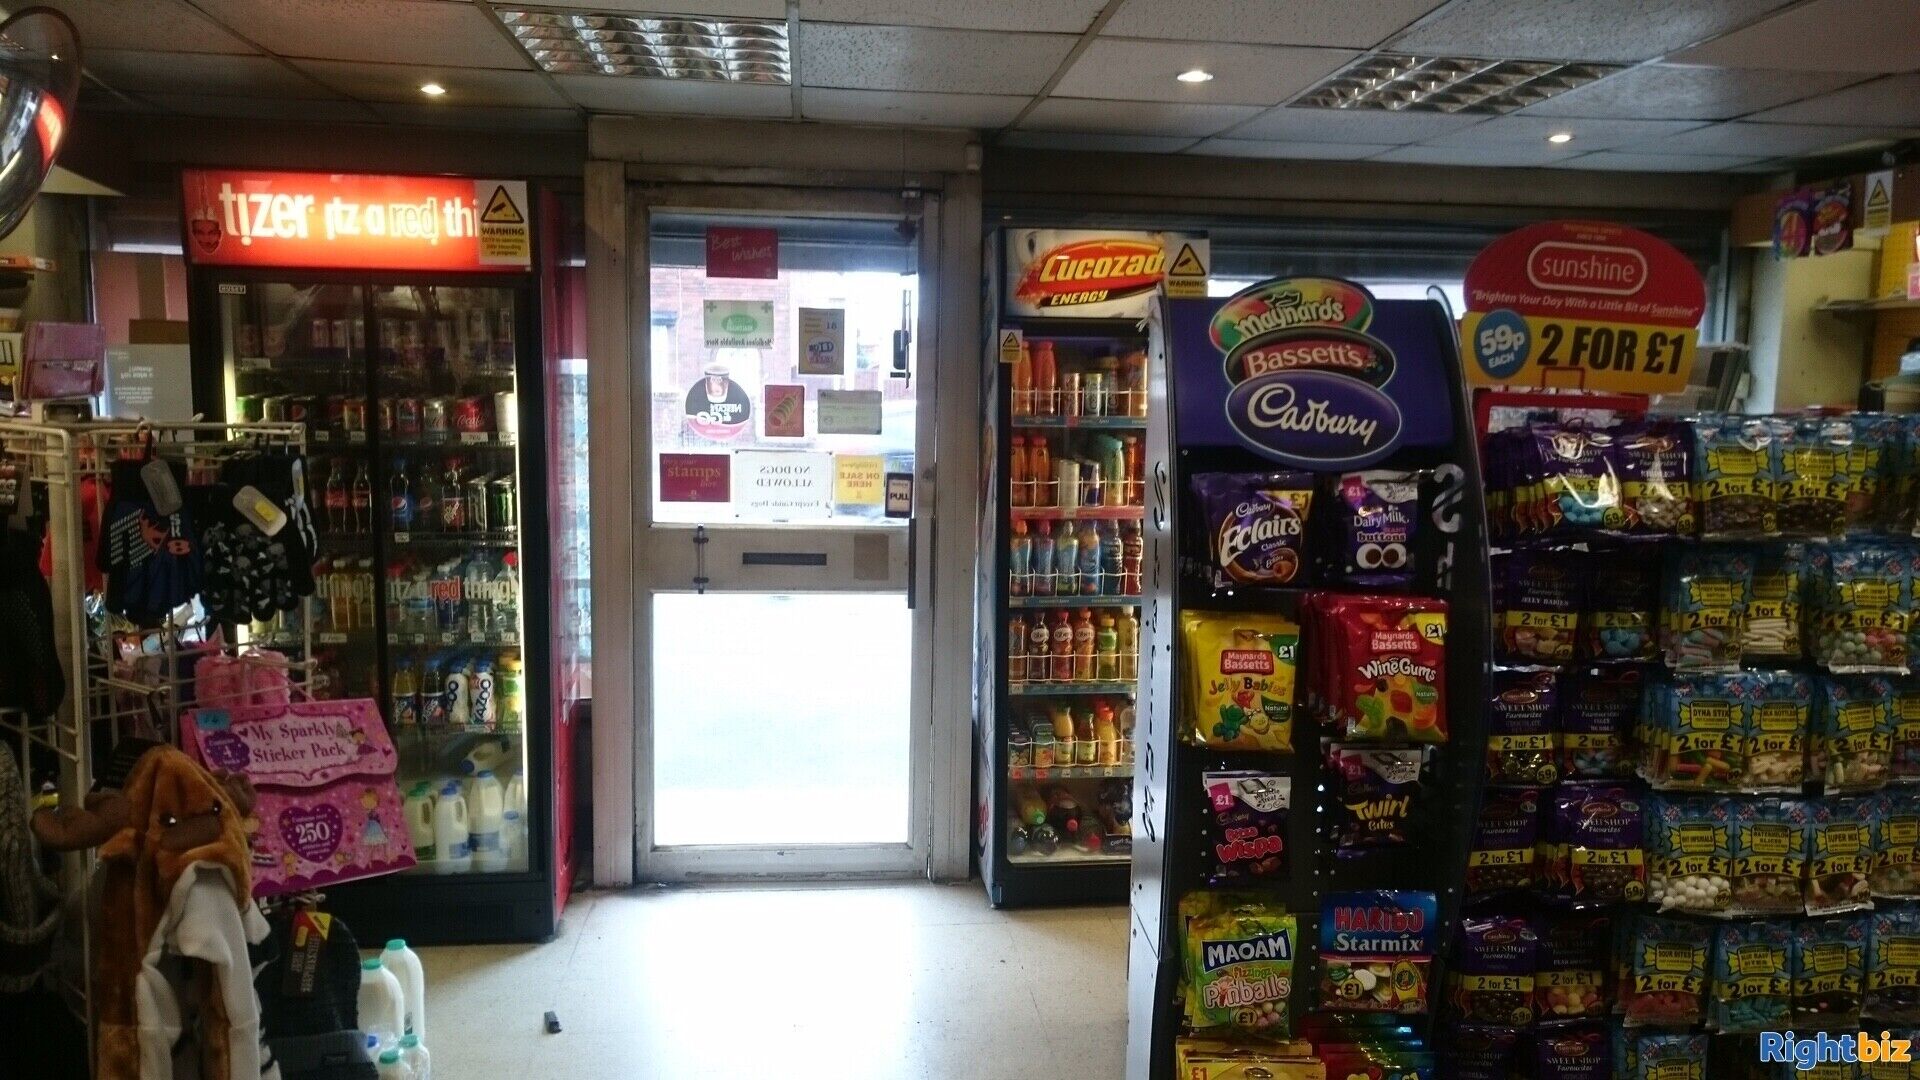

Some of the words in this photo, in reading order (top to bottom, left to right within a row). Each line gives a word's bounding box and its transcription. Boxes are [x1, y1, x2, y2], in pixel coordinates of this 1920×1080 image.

[388, 196, 439, 245] red
[481, 227, 525, 236] WARNING
[1541, 255, 1635, 283] sunshine
[1168, 280, 1206, 288] WARNING
[1051, 290, 1109, 305] ENERGY
[1519, 294, 1540, 305] Your
[1542, 295, 1562, 308] Day
[1565, 297, 1587, 308] With
[1590, 300, 1595, 308] a
[1598, 300, 1623, 311] Little
[1626, 302, 1638, 312] Bit
[1639, 303, 1650, 313] of
[1480, 325, 1525, 355] 59p
[1537, 324, 1563, 366] 2
[1569, 327, 1638, 372] FOR
[1643, 332, 1685, 374] £1
[1246, 344, 1363, 378] Bassett's
[1489, 352, 1515, 368] EACH
[1248, 383, 1377, 446] Cadbury
[667, 465, 721, 480] stamps
[1347, 486, 1361, 497] £1
[1639, 484, 1648, 495] 2
[1671, 483, 1685, 495] £1
[1707, 481, 1723, 496] 2
[1725, 482, 1746, 494] for
[1752, 479, 1773, 496] £1
[1780, 482, 1794, 498] 2
[1798, 485, 1820, 496] for
[890, 493, 909, 501] PULL
[1235, 502, 1271, 518] Cadbury
[1353, 515, 1381, 528] Dairy
[1382, 511, 1407, 524] Milk
[1220, 516, 1301, 567] Eclairs
[1357, 532, 1406, 542] buttons
[1261, 539, 1287, 551] Classic
[430, 575, 460, 600] red
[1755, 605, 1775, 616] for
[1521, 613, 1531, 625] 2
[1534, 616, 1547, 626] for
[1551, 615, 1568, 627] £1
[1605, 614, 1614, 625] 2
[1689, 613, 1701, 629] 2
[1704, 614, 1724, 626] for
[1838, 613, 1855, 628] 2
[1859, 615, 1876, 626] for
[1375, 632, 1414, 642] Maynards
[1425, 624, 1443, 638] £1
[1371, 639, 1418, 650] Bassetts
[1228, 652, 1267, 661] Maynards
[1279, 646, 1295, 659] £1
[1224, 659, 1270, 670] Bassetts
[1209, 678, 1240, 695] Jelly
[1243, 677, 1287, 696] Babies
[1264, 704, 1288, 712] Natural
[1693, 709, 1711, 717] DYNA
[251, 725, 271, 745] My
[280, 721, 335, 742] Sparkly
[1502, 737, 1512, 749] 2
[1515, 740, 1527, 749] for
[1529, 736, 1546, 749] £1
[1578, 736, 1588, 746] 2
[1591, 737, 1606, 747] for
[1677, 736, 1691, 751] 2
[1693, 738, 1715, 750] for
[1721, 733, 1744, 750] £1
[1751, 738, 1760, 754] 2
[1763, 738, 1784, 751] for
[1834, 737, 1848, 750] 2
[1853, 738, 1867, 751] for
[1870, 733, 1892, 750] £1
[252, 746, 305, 763] Sticker
[312, 742, 347, 759] Pack
[1346, 794, 1409, 821] Twirl
[295, 820, 330, 843] 250
[1368, 819, 1394, 831] Bites
[1479, 853, 1489, 865] 2
[1492, 855, 1504, 864] for
[1506, 851, 1524, 863] £1
[1587, 852, 1596, 863] 2
[1610, 851, 1629, 863] £1
[1877, 851, 1890, 866] 2
[1892, 853, 1910, 864] for
[1669, 860, 1683, 876] 2
[1686, 862, 1703, 873] for
[1707, 858, 1732, 874] £1
[1737, 860, 1750, 876] 2
[1754, 862, 1778, 873] for
[1815, 860, 1826, 876] 2
[1831, 862, 1849, 874] for
[1853, 856, 1872, 872] £1
[1626, 885, 1644, 897] 59p
[1334, 906, 1424, 932] HARIBO
[1335, 933, 1421, 952] Starmix
[1207, 936, 1287, 967] MAOAM
[1478, 977, 1486, 990] 2
[1488, 980, 1501, 989] for
[1503, 977, 1521, 990] £1
[1551, 973, 1560, 985] 2
[1562, 975, 1574, 985] for
[1577, 972, 1595, 984] £1
[1640, 974, 1652, 991] 2
[1657, 978, 1678, 991] for
[1802, 979, 1816, 993] 2
[1818, 978, 1835, 991] for
[1876, 973, 1888, 987] 2
[1890, 972, 1910, 986] for
[1344, 983, 1360, 995] £1
[1728, 985, 1740, 1000] 2
[1744, 982, 1762, 994] for
[1239, 1010, 1254, 1024] £1
